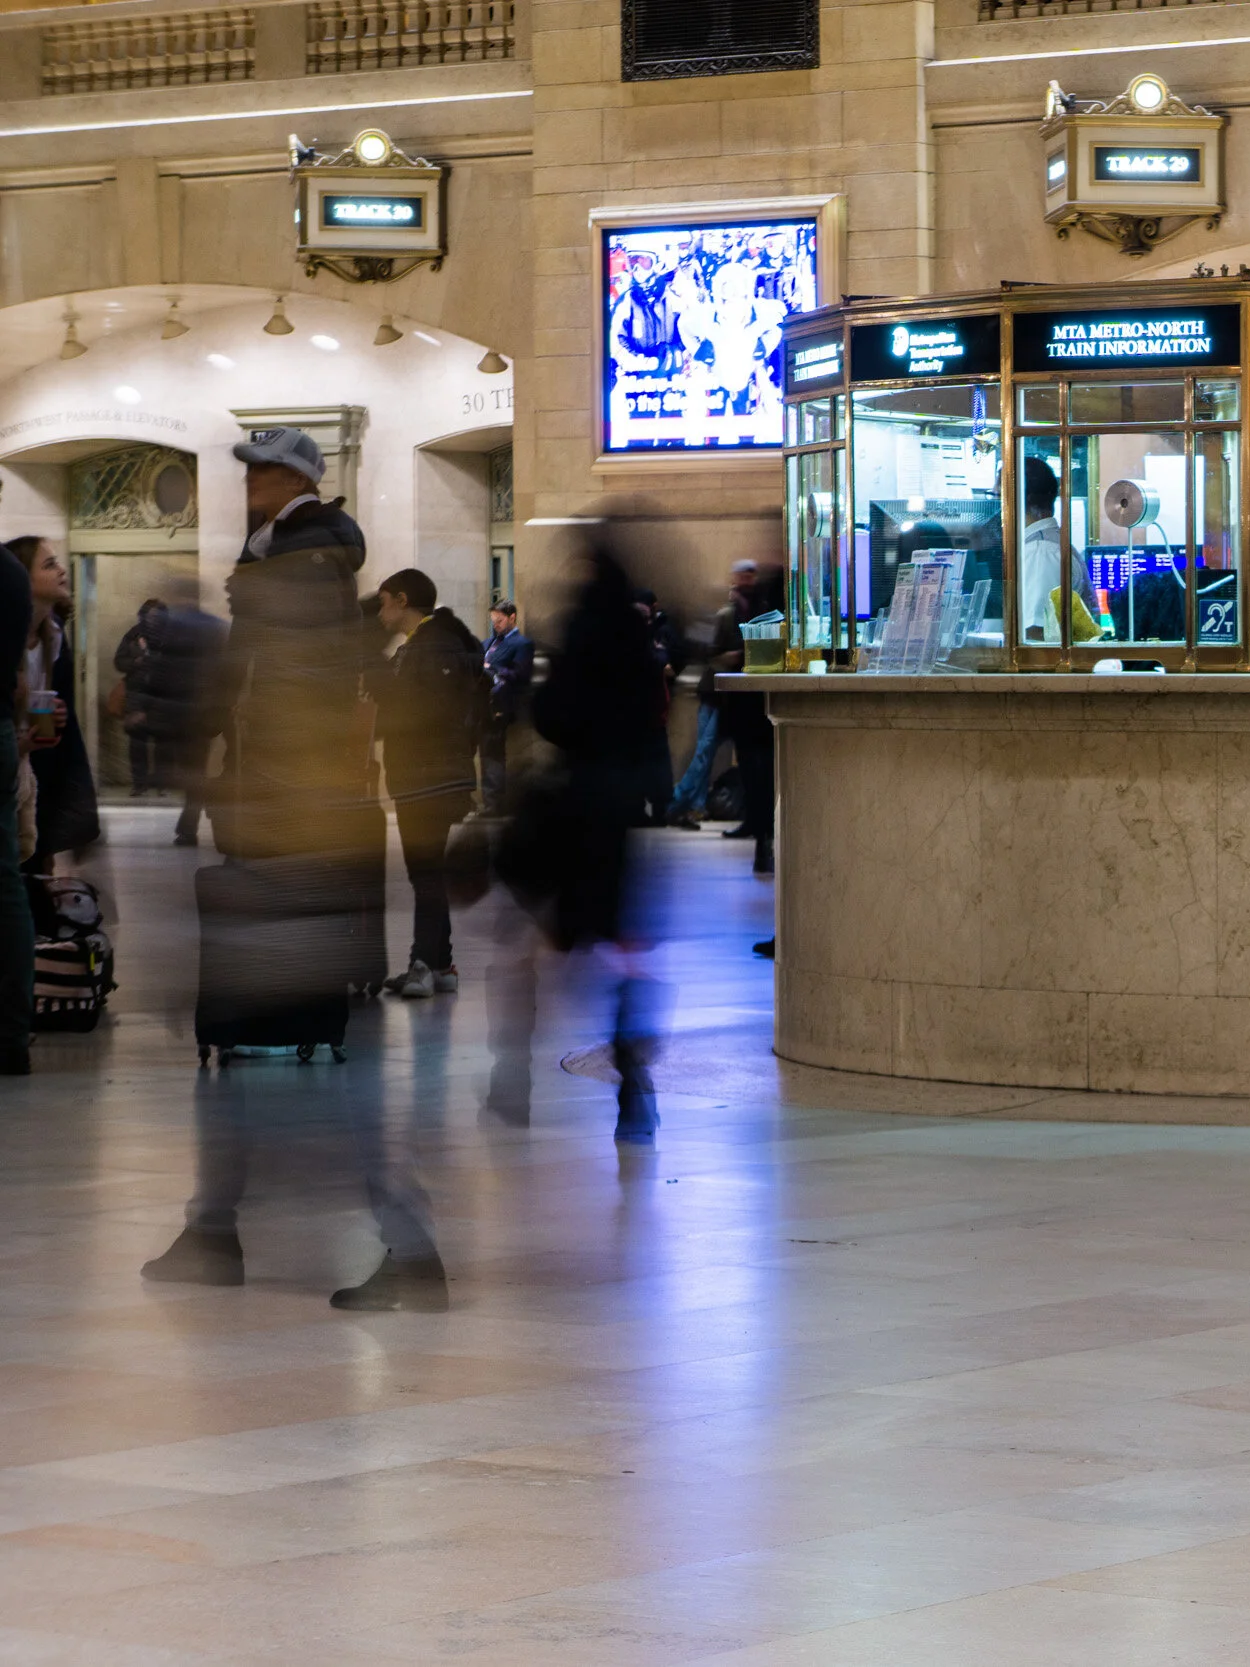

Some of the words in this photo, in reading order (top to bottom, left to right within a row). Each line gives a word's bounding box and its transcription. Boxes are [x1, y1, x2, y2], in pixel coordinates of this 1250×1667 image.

[1106, 156, 1168, 172] TRACK
[333, 204, 392, 218] TRACK
[1053, 324, 1087, 340] MTA
[1089, 320, 1204, 338] METRO-NORTH
[1047, 341, 1096, 358] TRAIN
[1098, 338, 1211, 356] INFORMATION
[462, 392, 484, 415] 30
